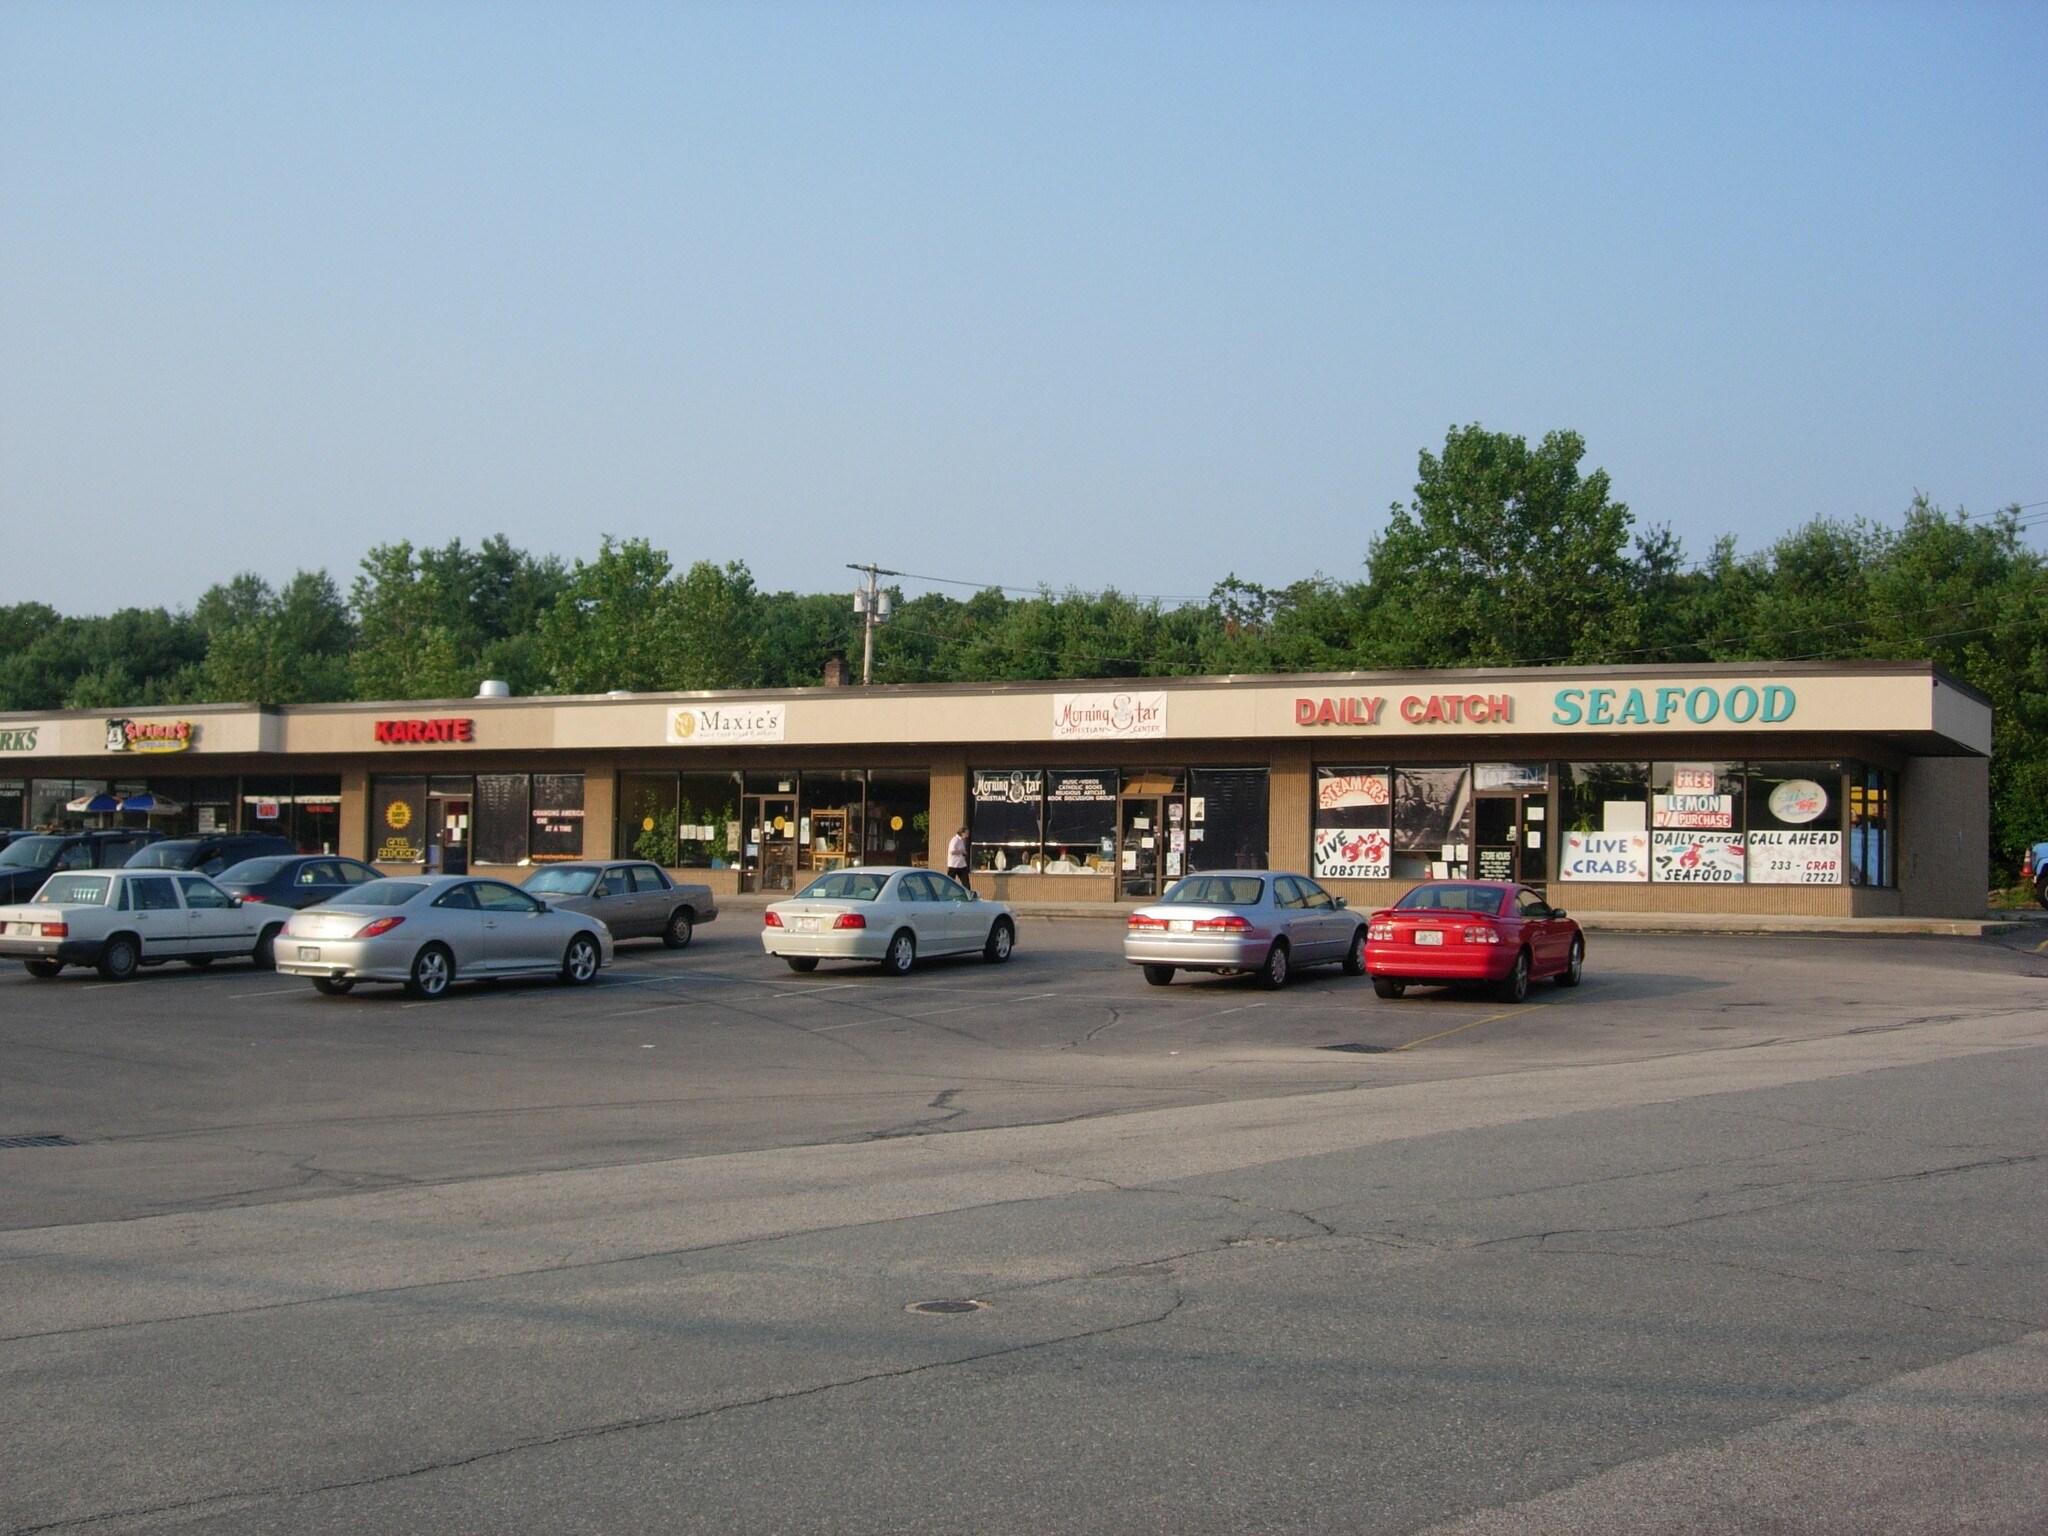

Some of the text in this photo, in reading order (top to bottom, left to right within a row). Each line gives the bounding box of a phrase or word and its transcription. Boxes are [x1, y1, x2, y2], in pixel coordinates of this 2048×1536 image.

[1055, 694, 1159, 730] Morning Star
[1295, 694, 1511, 725] DAILY CATCH
[1552, 685, 1797, 725] SEAFOOD
[701, 709, 778, 731] Maxie's
[375, 718, 473, 743] KARATE
[1061, 725, 1160, 735] CHRISTIAN CENTER
[972, 775, 1008, 796] Morning
[1676, 771, 1713, 788] FREE
[1320, 775, 1389, 806] STEAMERS
[1668, 795, 1721, 812] LEMON
[1656, 812, 1731, 827] W/ PURCHASE
[386, 838, 408, 847] CALL
[1585, 839, 1628, 853] LIVE
[1655, 833, 1744, 845] DAILY CATCH
[1750, 833, 1839, 845] CALL AHEAD
[1314, 830, 1348, 865] LIVE
[1322, 865, 1390, 877] LOBSTERS
[1573, 860, 1637, 873] CRABS
[1771, 861, 1792, 870] 233
[1806, 861, 1836, 870] CRAB
[1665, 869, 1732, 881] SEAFOOD
[1801, 872, 1839, 883] (2722)
